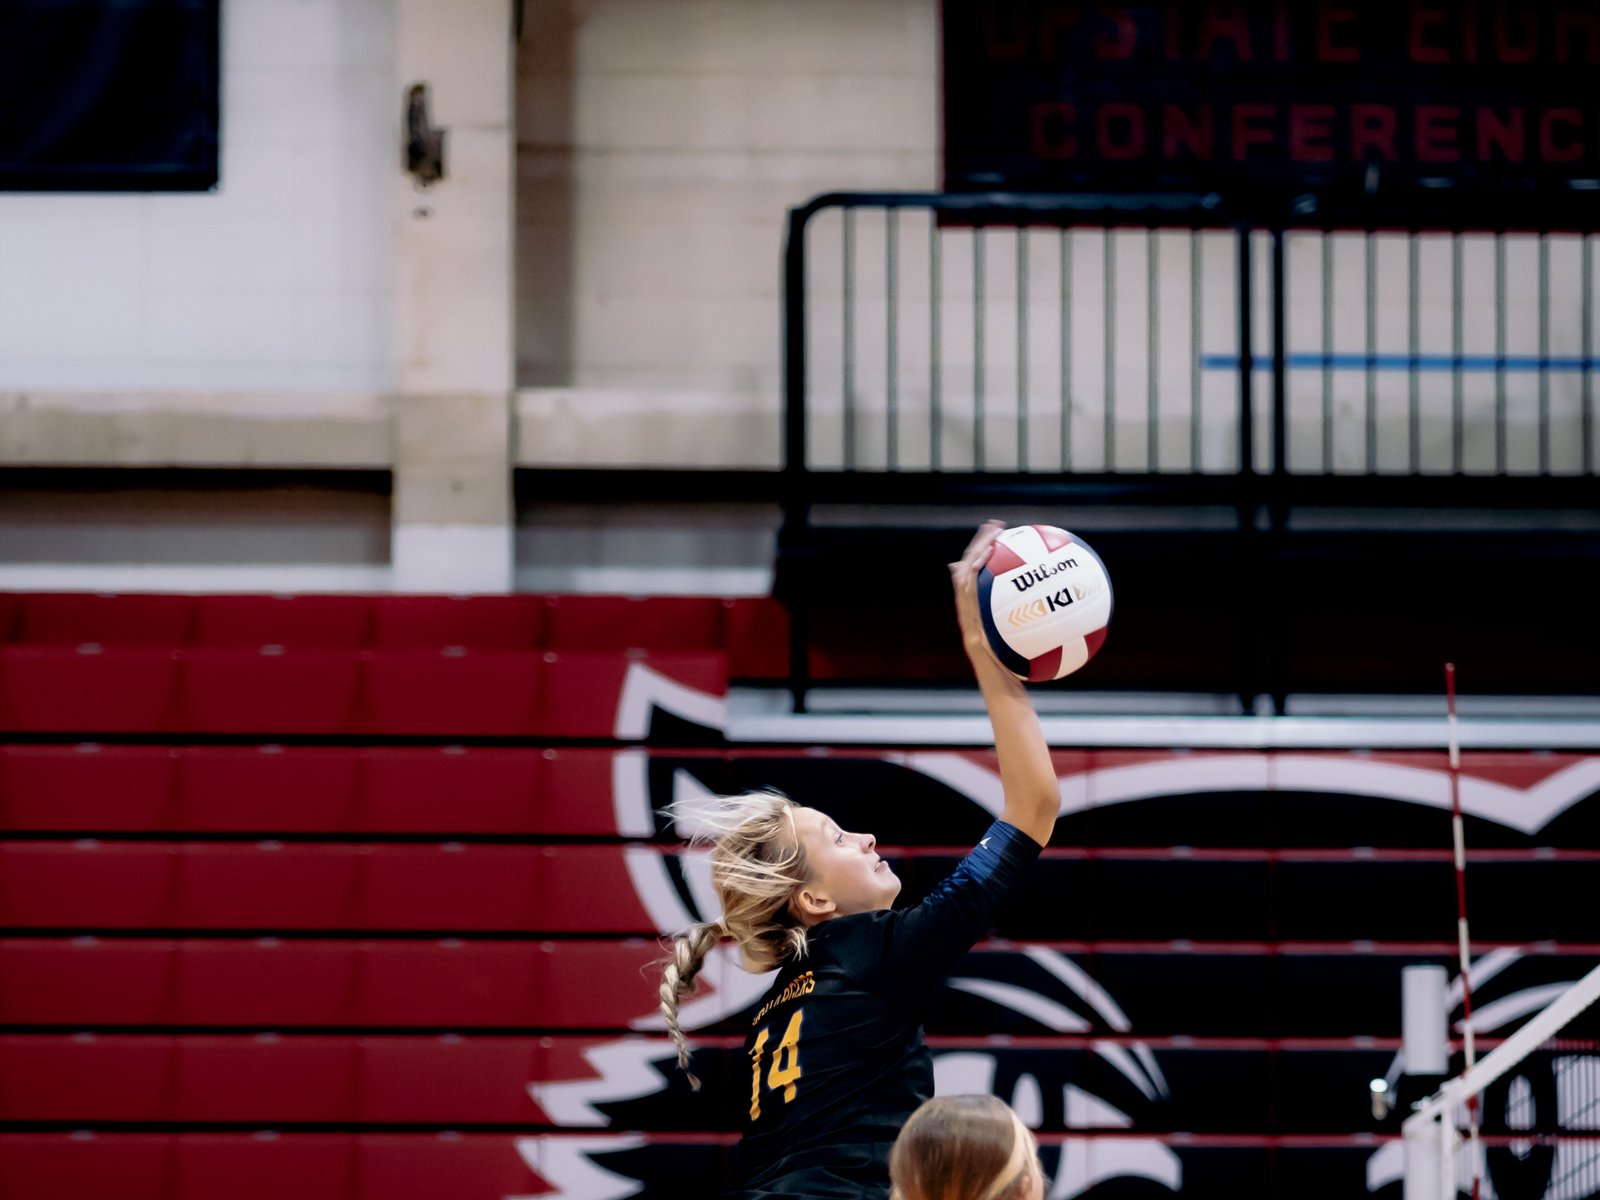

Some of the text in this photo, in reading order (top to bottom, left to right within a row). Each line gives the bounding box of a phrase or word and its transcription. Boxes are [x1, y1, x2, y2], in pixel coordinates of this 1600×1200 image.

[1028, 101, 1600, 162] CONFERENC
[1011, 558, 1079, 592] Wilson
[748, 1007, 804, 1121] 14
